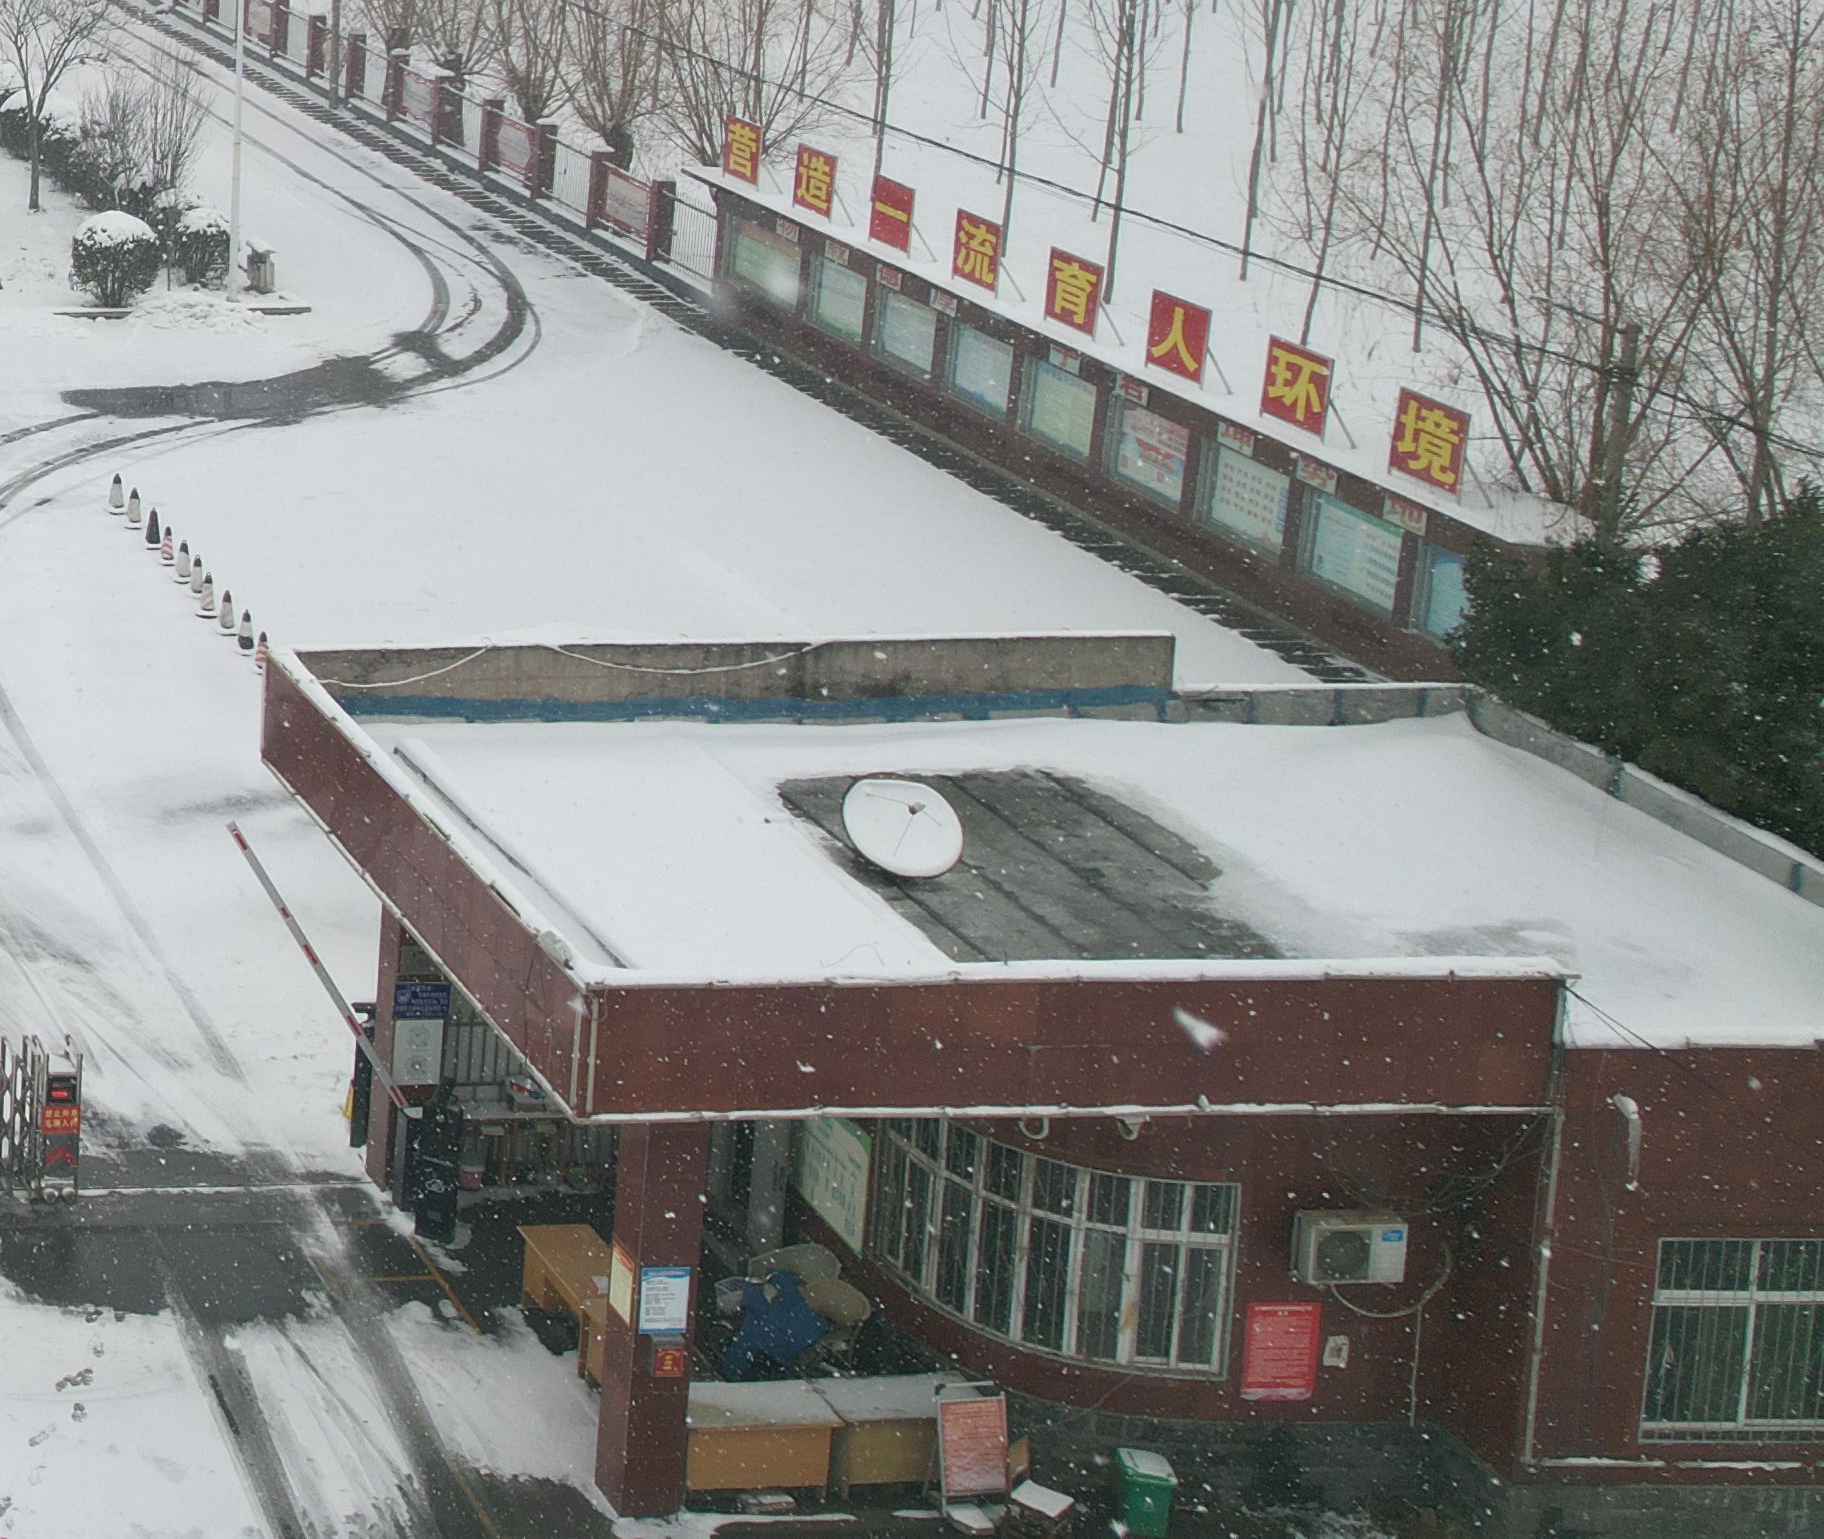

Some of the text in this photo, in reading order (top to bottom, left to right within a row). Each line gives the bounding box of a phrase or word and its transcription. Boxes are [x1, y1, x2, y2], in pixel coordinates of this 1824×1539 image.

[726, 121, 1460, 485] 营造一流育人环境
